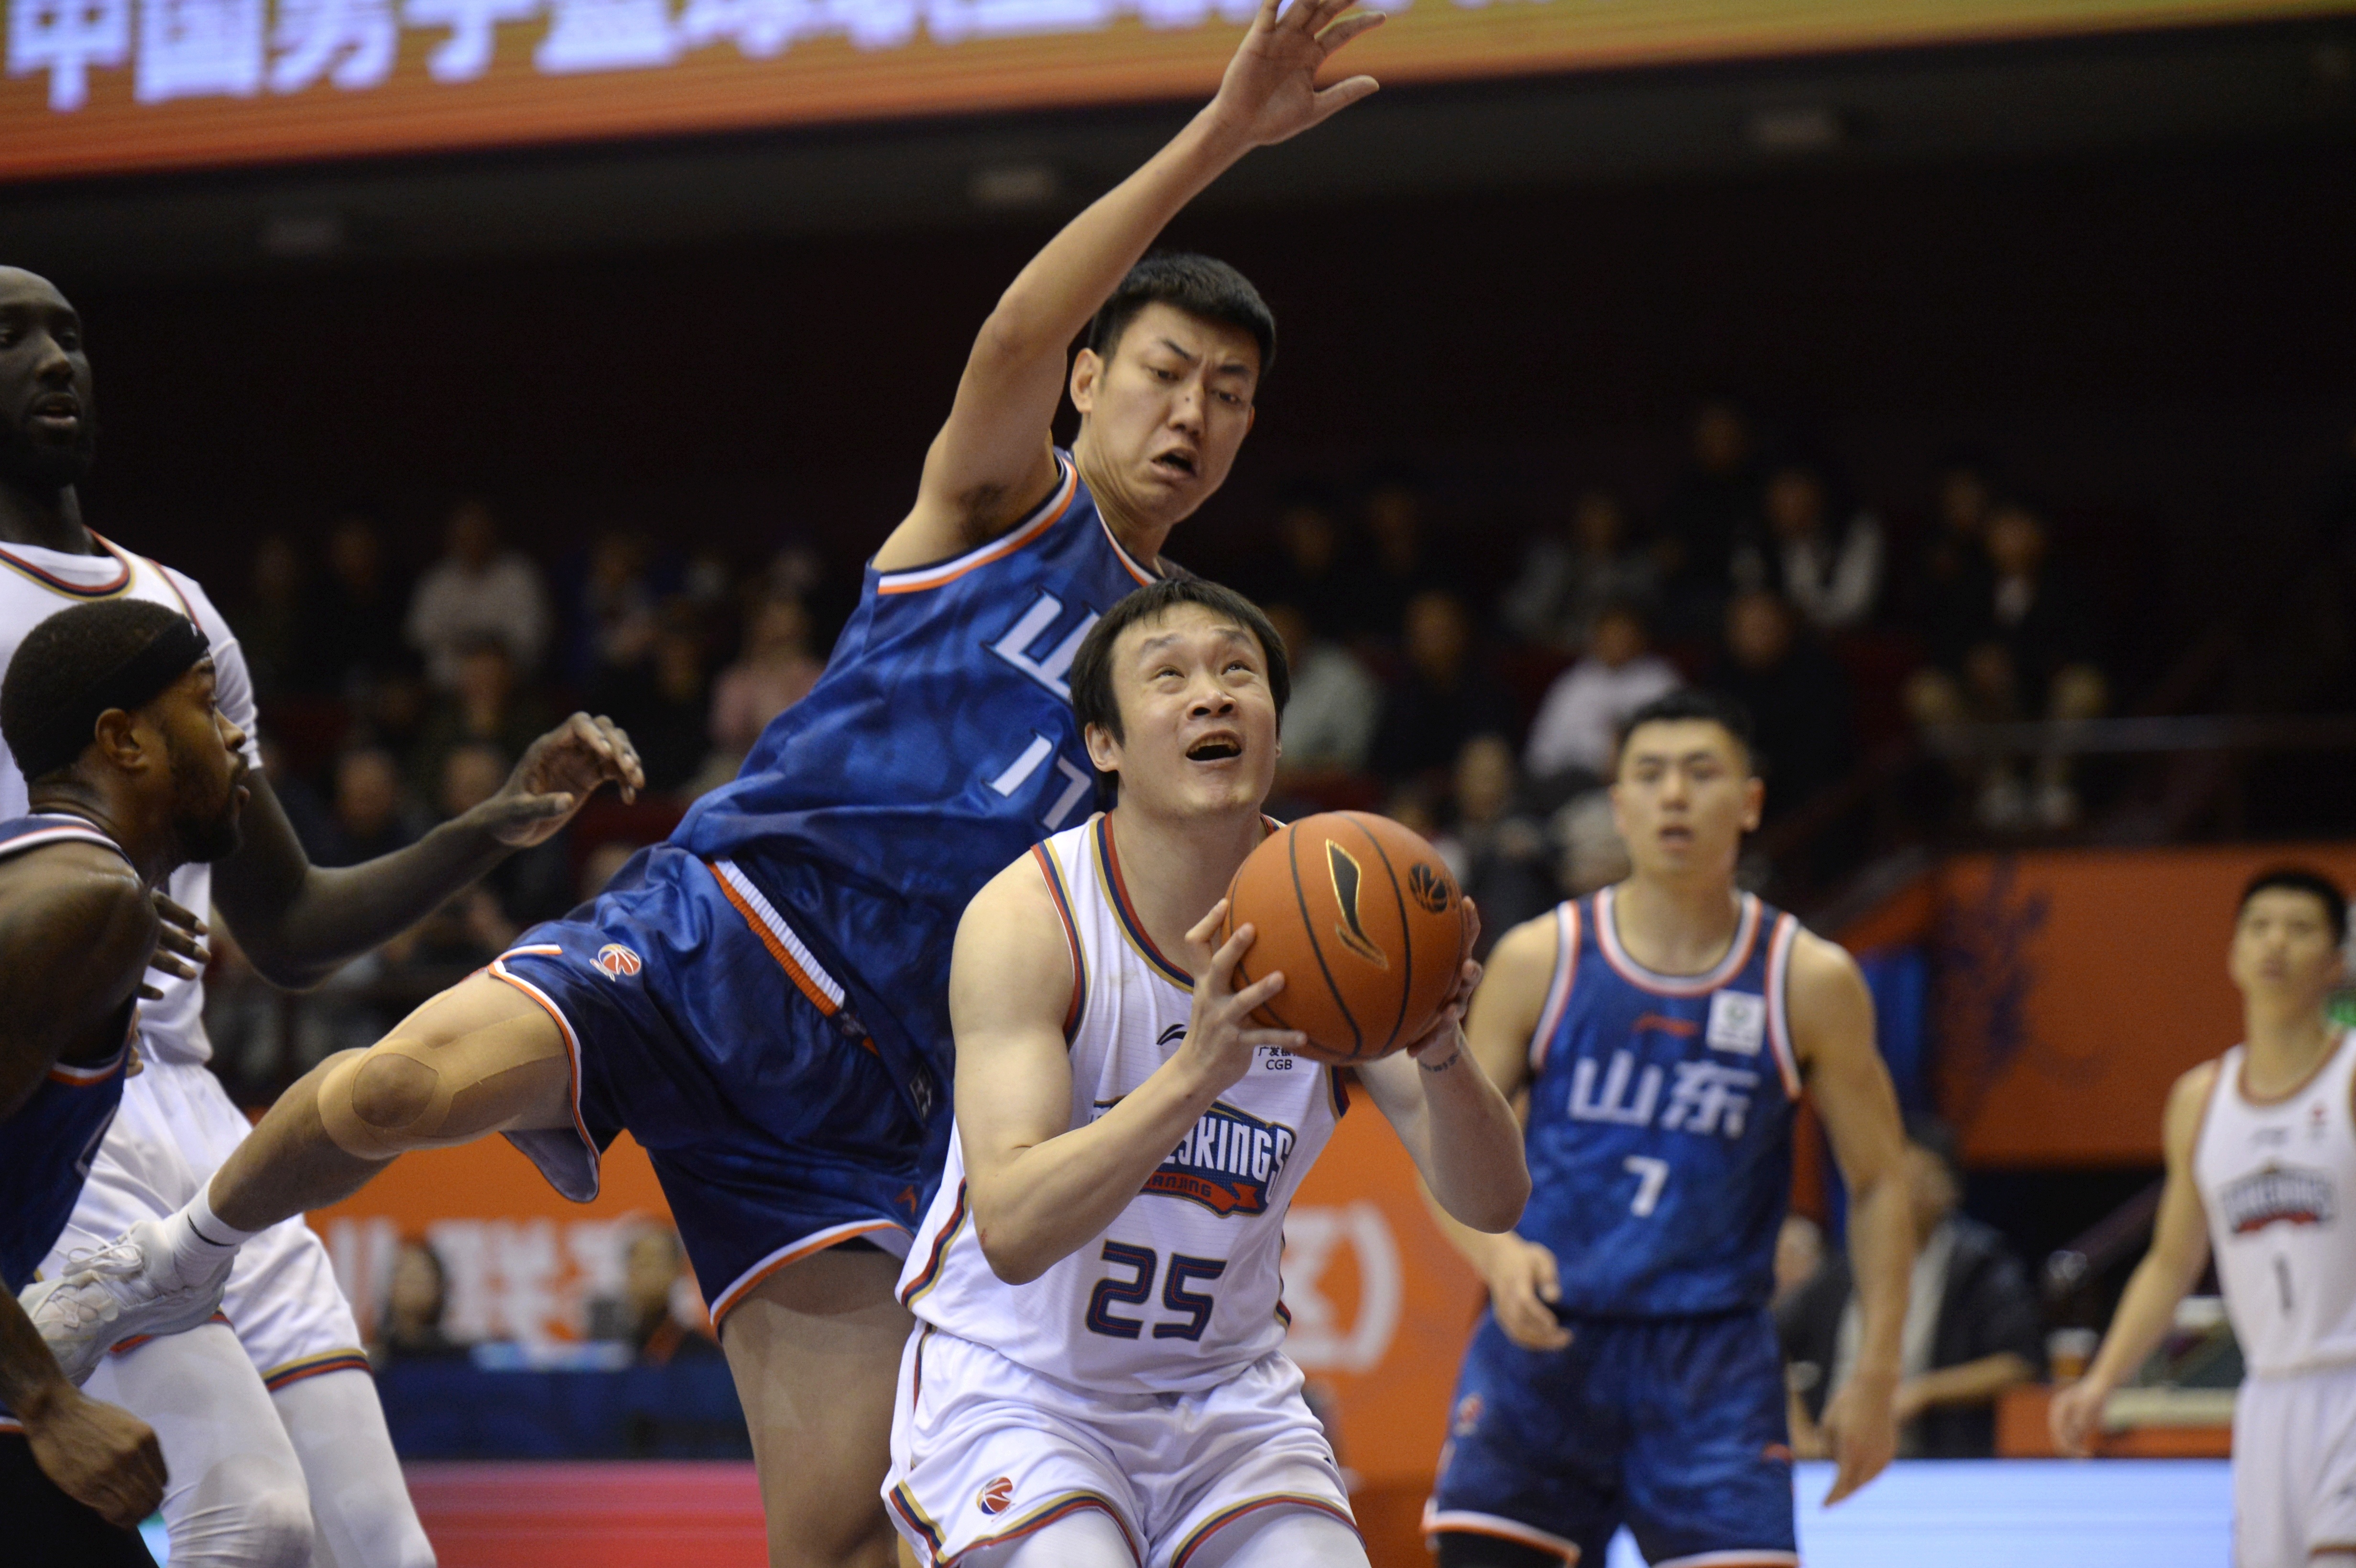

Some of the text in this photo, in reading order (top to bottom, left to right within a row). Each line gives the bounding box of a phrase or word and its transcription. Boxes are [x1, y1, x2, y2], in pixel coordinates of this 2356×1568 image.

[990, 733, 1093, 832] 17
[1266, 1059, 1293, 1070] CGB
[1567, 1049, 1761, 1140] 山东
[1145, 1174, 1212, 1198] ANJING
[1624, 1154, 1670, 1218] 7
[1085, 1240, 1227, 1341] 25
